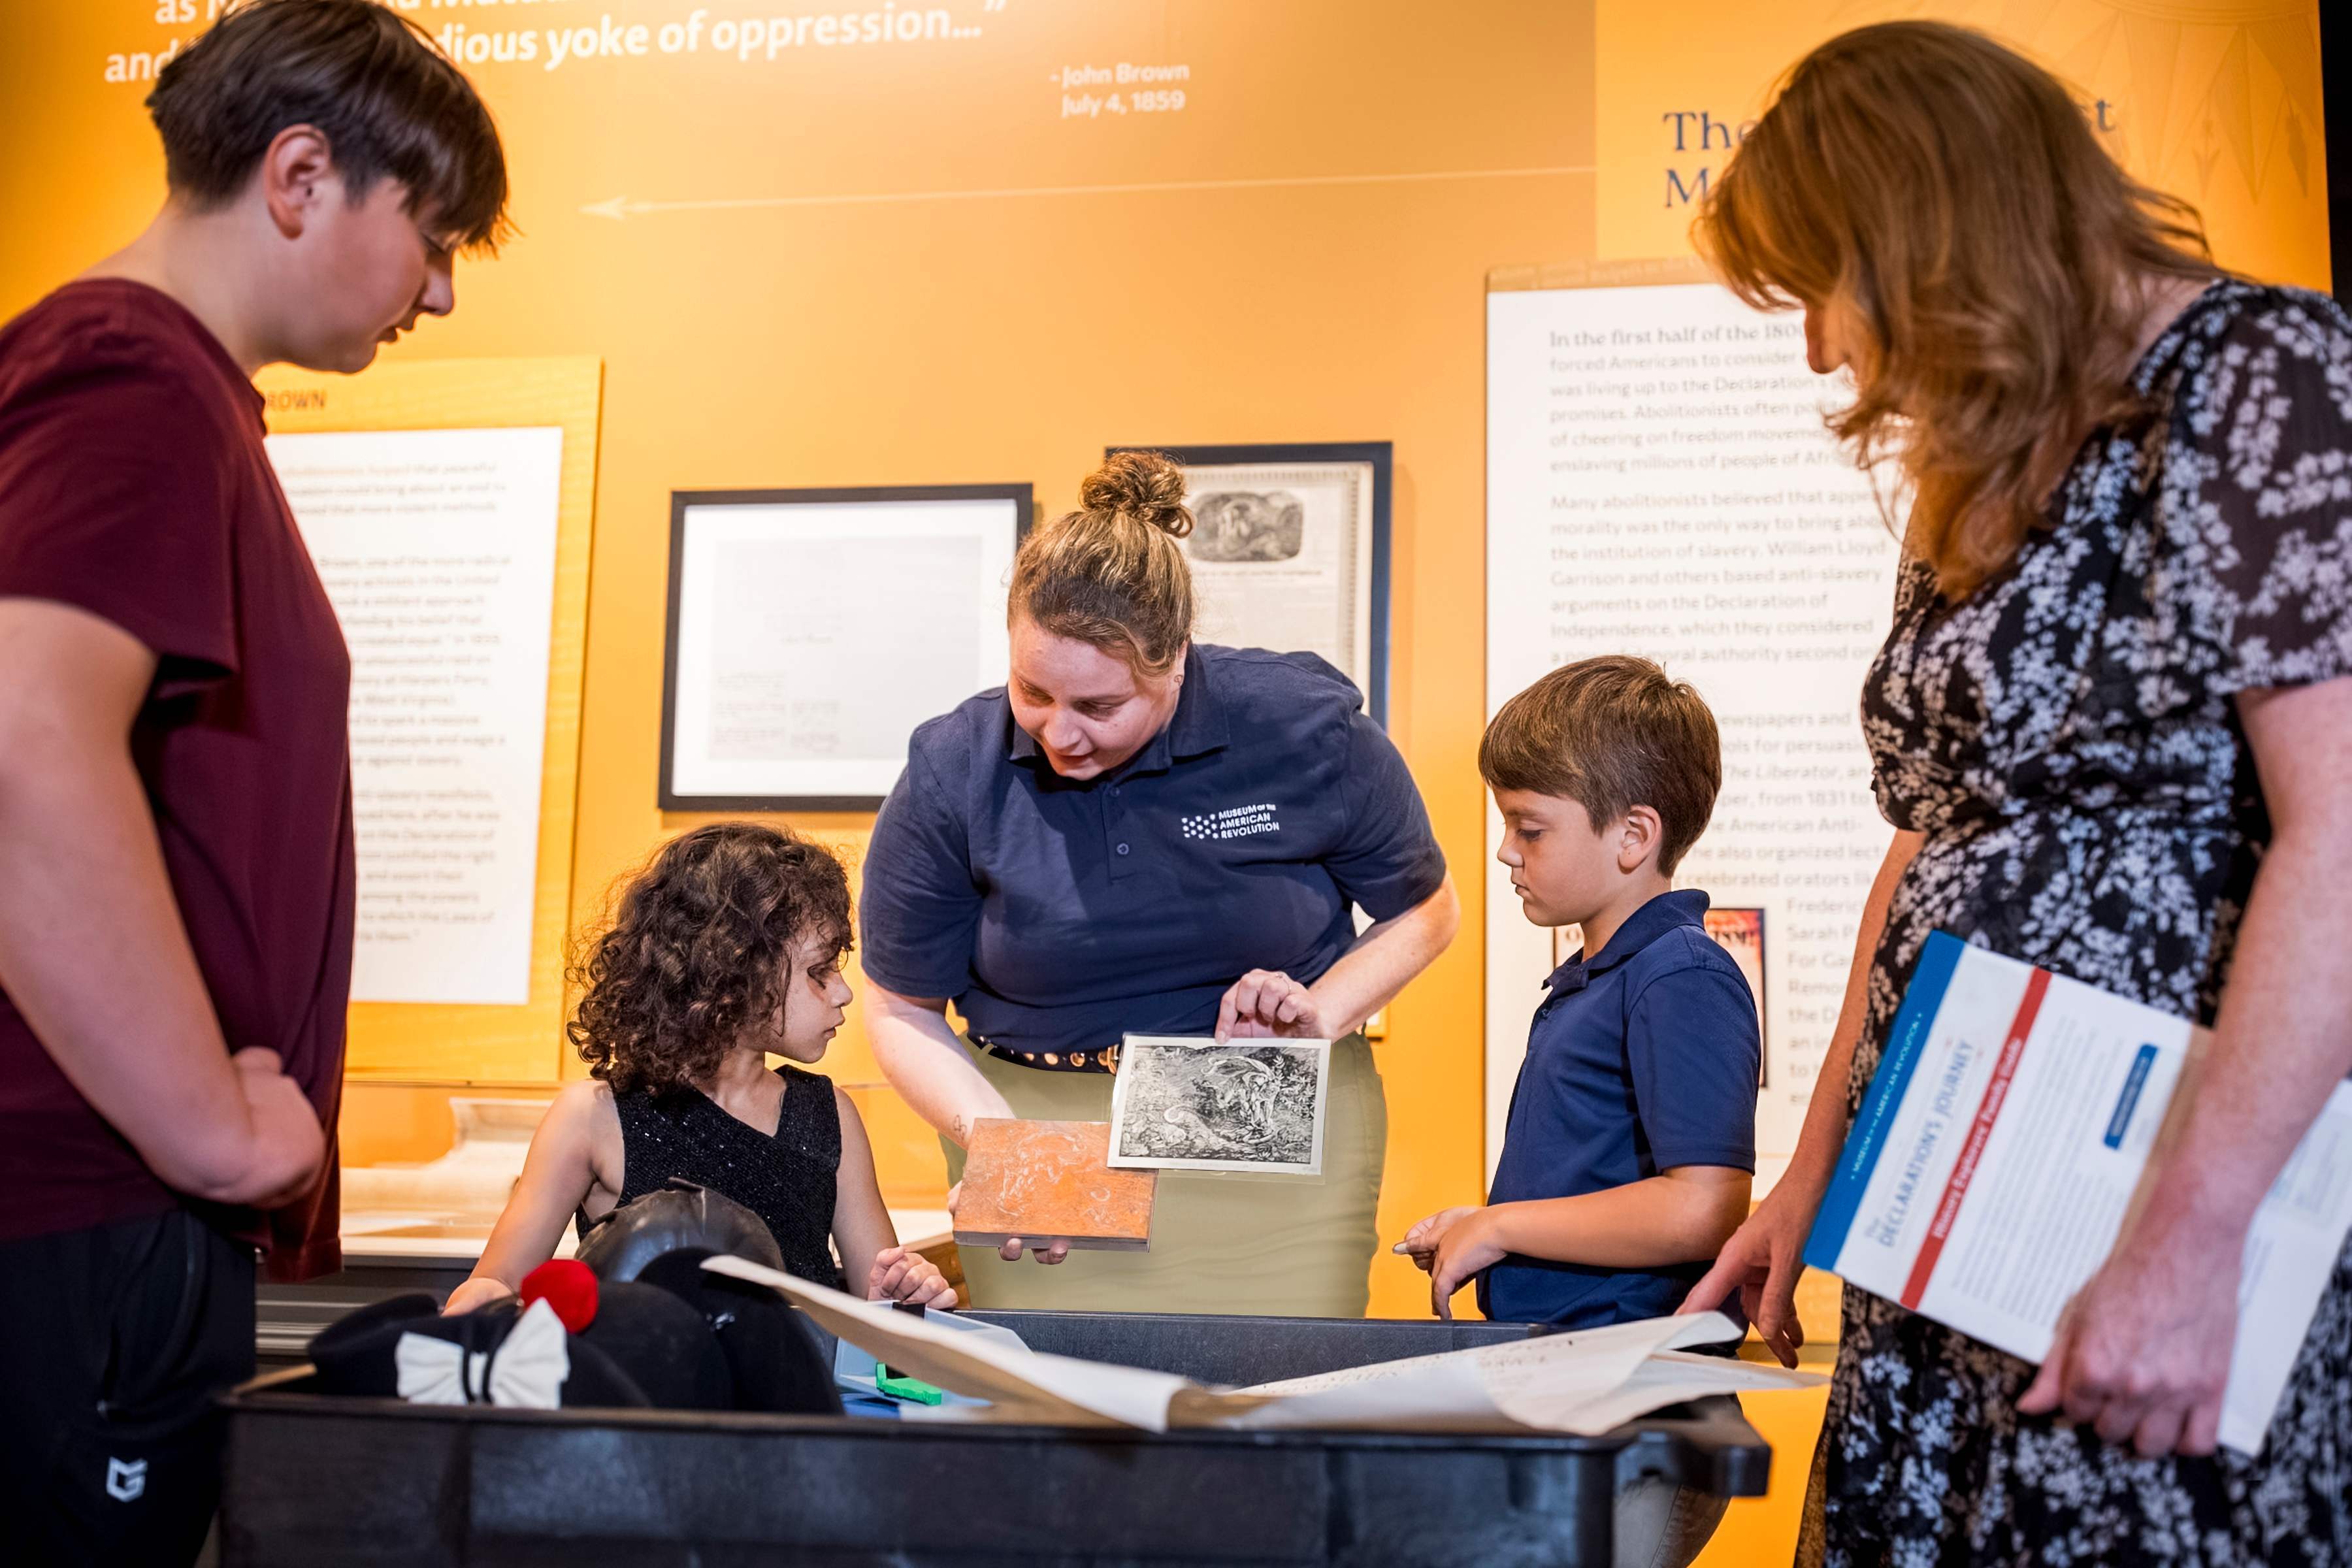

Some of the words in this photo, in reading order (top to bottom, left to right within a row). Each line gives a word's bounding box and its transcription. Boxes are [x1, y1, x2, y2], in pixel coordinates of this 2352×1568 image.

[544, 14, 649, 71] yoke
[657, 9, 708, 53] of
[1062, 64, 1113, 90] John
[1116, 63, 1190, 84] Brown
[1062, 93, 1102, 119] July
[1105, 93, 1128, 116] 4,
[1131, 88, 1186, 112] 1859
[1549, 331, 1569, 348] In
[1574, 331, 1605, 346] the
[1611, 329, 1651, 345] first
[1658, 327, 1697, 343] half
[1701, 325, 1722, 342] of
[1727, 325, 1759, 340] the
[1549, 357, 1605, 372] forced
[1609, 356, 1699, 368] Americans
[1703, 354, 1721, 367] to
[1724, 351, 1796, 366] consider
[1549, 385, 1582, 397] was
[1587, 384, 1629, 398] living
[1635, 383, 1656, 396] up
[1659, 381, 1676, 393] to
[1683, 380, 1709, 392] the
[1633, 404, 1739, 419] Abolitionists
[1744, 402, 1790, 416] often
[1549, 432, 1569, 447] of
[1572, 433, 1642, 448] cheering
[1647, 433, 1668, 445] on
[1672, 429, 1744, 442] freedom
[1549, 459, 1625, 473] enslaving
[1631, 455, 1695, 469] millions
[1698, 454, 1717, 468] of
[1721, 454, 1778, 469] people
[1782, 451, 1800, 465] of
[1550, 496, 1597, 510] Many
[1602, 494, 1707, 508] abolitionists
[1712, 492, 1783, 506] believed
[1787, 491, 1823, 504] that
[1550, 521, 1621, 536] morality
[1626, 523, 1658, 534] was
[1663, 519, 1691, 532] the
[1696, 518, 1731, 534] only
[1736, 520, 1770, 532] way
[1774, 517, 1794, 531] to
[1799, 517, 1842, 532] bring
[1550, 547, 1578, 560] the
[1583, 547, 1670, 560] institution
[1675, 543, 1694, 558] of
[1768, 542, 1833, 556] William
[1550, 571, 1624, 586] Garrison
[1629, 571, 1659, 585] and
[1663, 571, 1719, 584] others
[1723, 569, 1774, 583] based
[1550, 598, 1642, 615] arguments
[1646, 598, 1667, 611] on
[1672, 596, 1700, 610] the
[1705, 595, 1805, 610] Declaration
[1809, 593, 1829, 607] of
[1550, 624, 1675, 639] Independence,
[1680, 621, 1730, 636] which
[1735, 621, 1772, 636] they
[1776, 619, 1874, 634] considered
[1701, 648, 1780, 662] authority
[1786, 645, 1848, 661] second
[1716, 714, 1814, 732] ewspapers
[1818, 712, 1851, 726] and
[1754, 737, 1782, 753] for
[1756, 765, 1844, 780] Liberator,
[1759, 791, 1803, 806] from
[1808, 790, 1846, 806] 1831
[1850, 792, 1870, 803] to
[1218, 804, 1257, 820] MUSEUM
[1220, 812, 1271, 830] AMERICAN
[1220, 822, 1280, 839] REVOLUTION
[1730, 818, 1813, 833] American
[1717, 846, 1752, 860] also
[1756, 846, 1844, 863] organized
[1685, 872, 1779, 887] celebrated
[1784, 874, 1850, 887] orators
[1786, 924, 1838, 941] Sarah
[1788, 951, 1817, 968] For
[1788, 1008, 1817, 1023] the
[1788, 1038, 1810, 1049] an
[1933, 1039, 1974, 1119] JOURNEY
[1854, 1136, 1871, 1172] MUSEUM
[1876, 1073, 1897, 1117] AMERICAN
[1895, 1021, 1919, 1071] REVOLUTION
